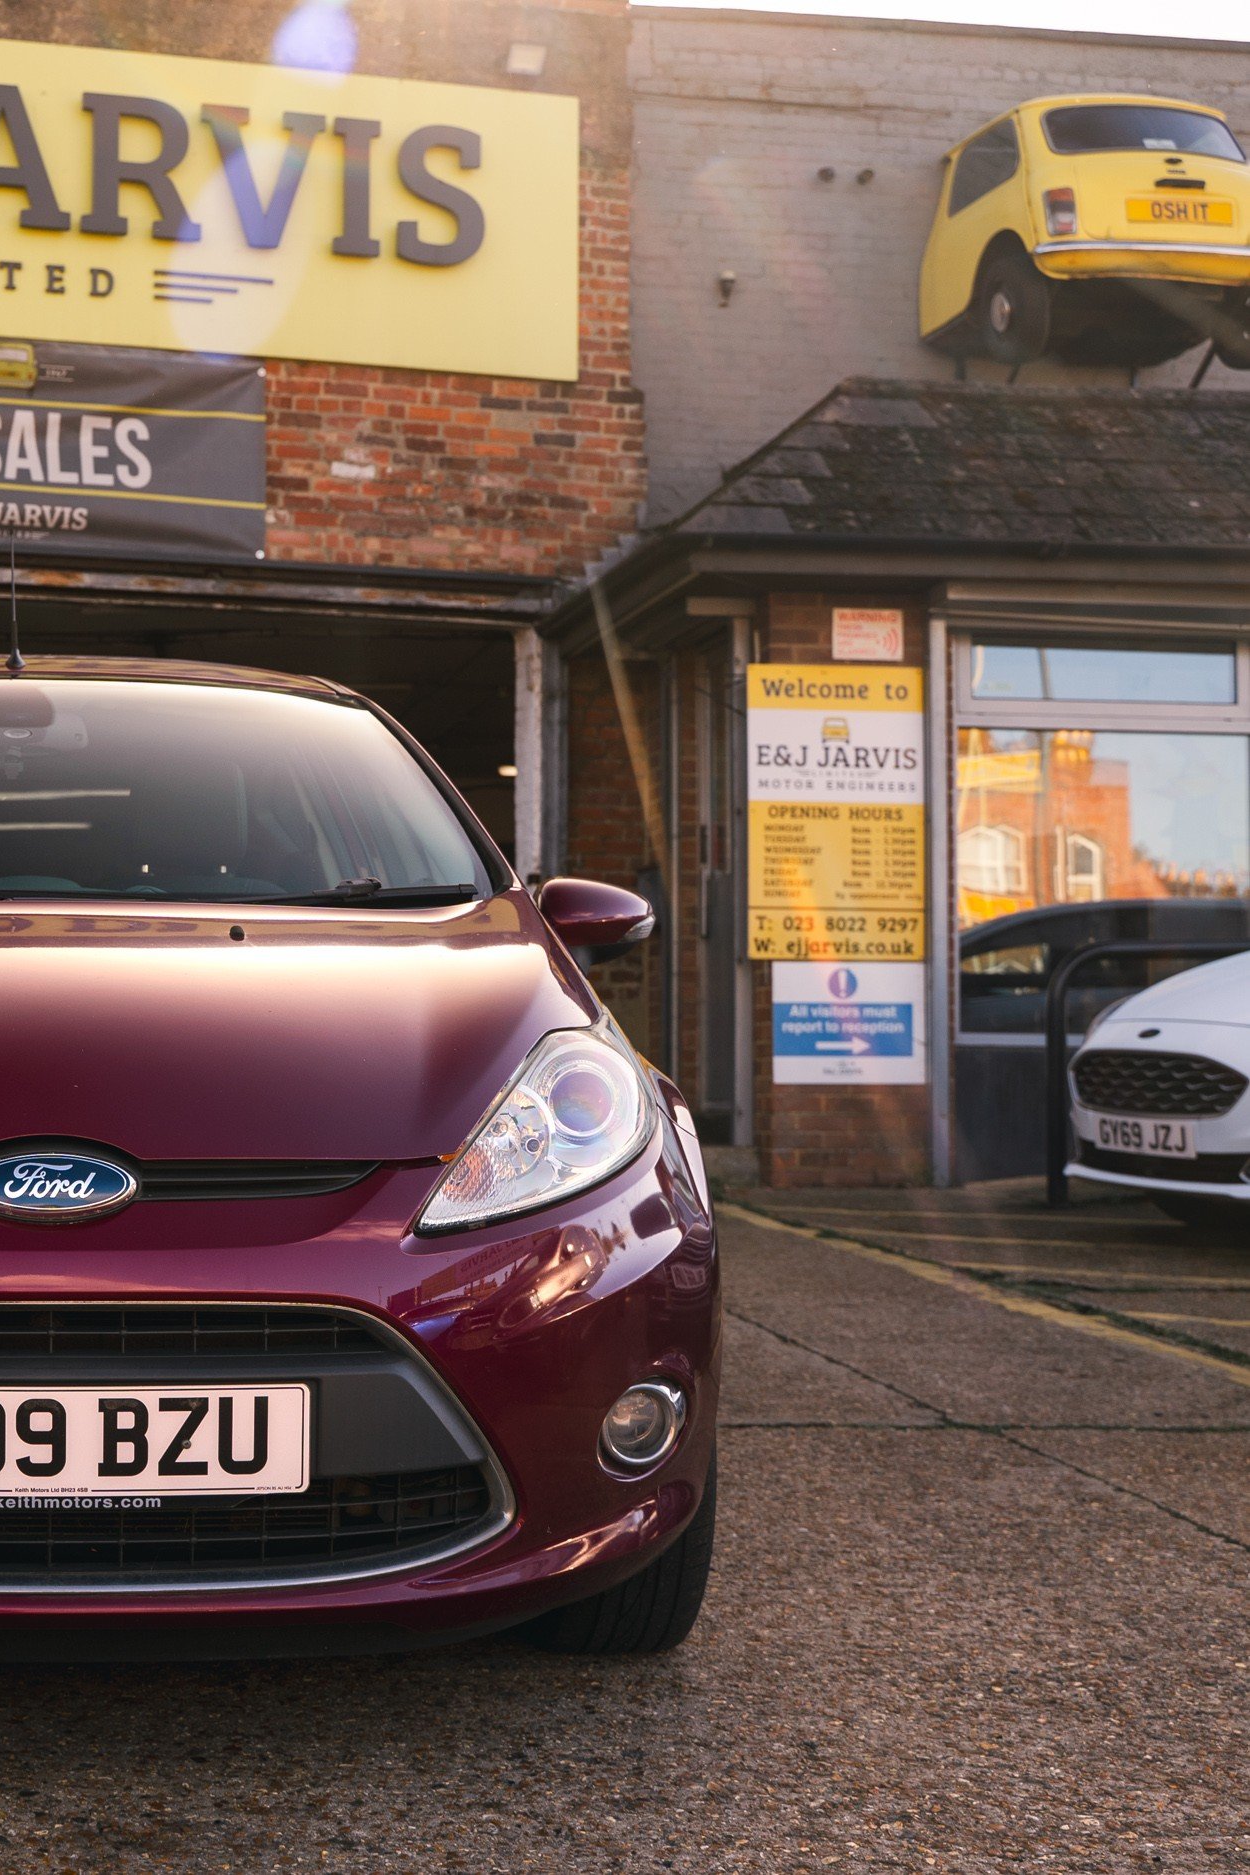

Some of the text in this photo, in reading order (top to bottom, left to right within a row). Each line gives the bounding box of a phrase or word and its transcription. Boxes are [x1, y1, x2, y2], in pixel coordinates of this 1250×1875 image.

[761, 678, 909, 700] Welcome to
[756, 744, 918, 770] E&J JARVIS
[758, 778, 918, 792] MOTOR ENGINEERS
[767, 805, 904, 821] OPENING HOURS
[756, 916, 919, 932] T: 023 8022 9297
[786, 937, 915, 960] ejjarvis.co.uk
[789, 1004, 898, 1019] All visitors must
[781, 1020, 905, 1036] report to reception
[1099, 1117, 1187, 1153] GY69 JZJ
[3, 1162, 97, 1199] Ford
[97, 1395, 269, 1477] BZU
